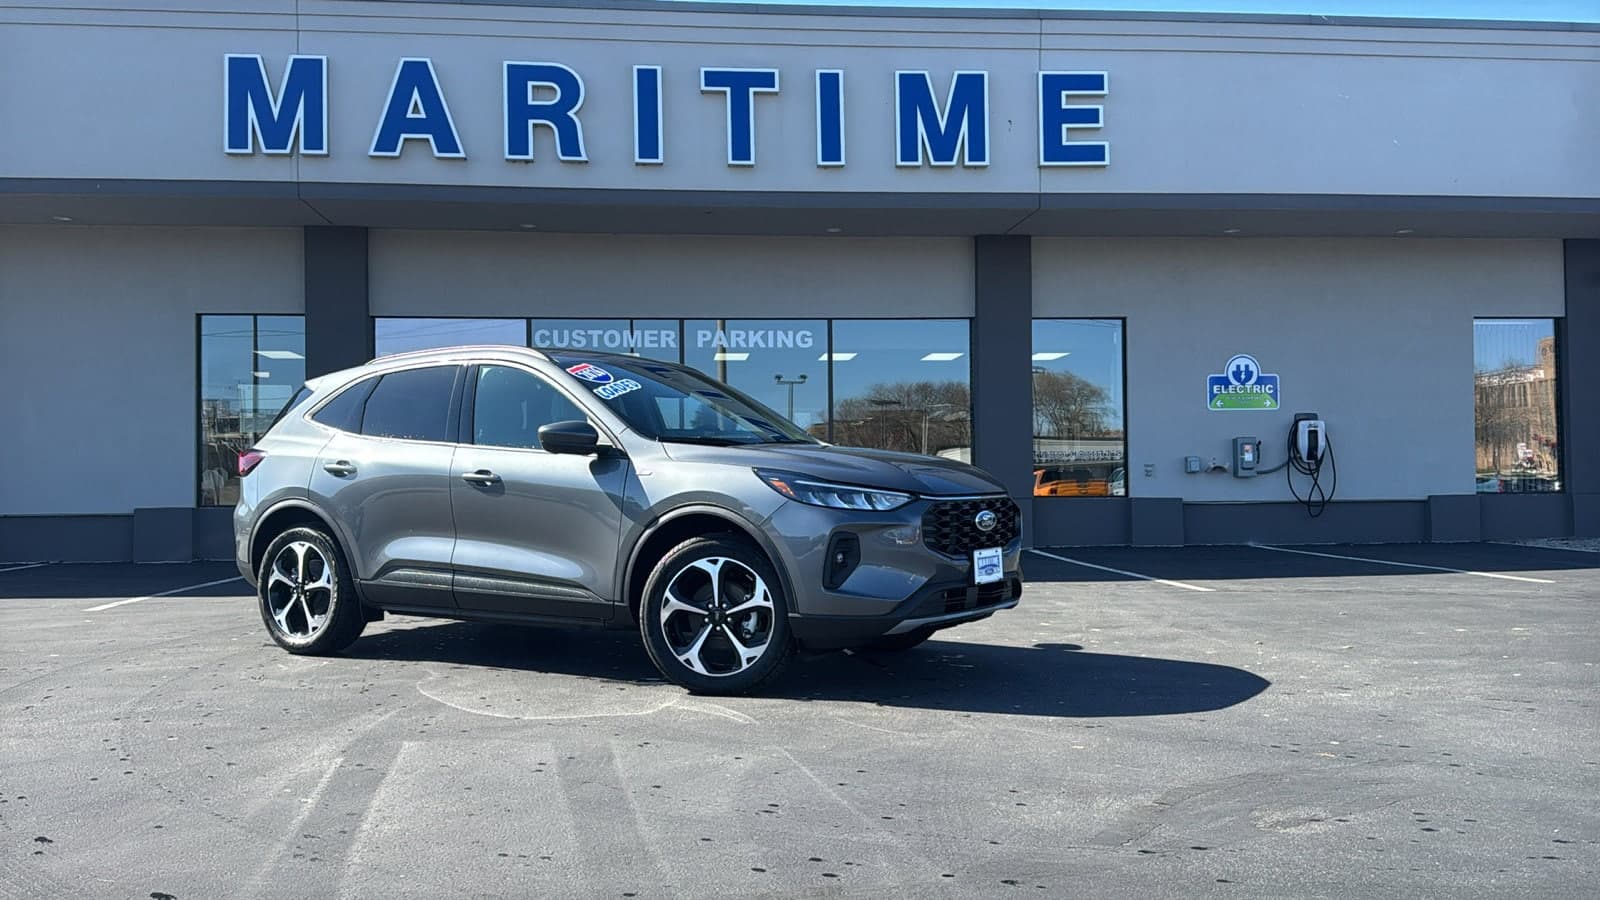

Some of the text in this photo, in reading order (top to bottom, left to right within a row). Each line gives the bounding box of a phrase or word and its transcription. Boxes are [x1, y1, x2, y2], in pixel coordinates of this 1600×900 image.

[223, 54, 1110, 168] MARITIME
[534, 329, 814, 348] CUSTOMER PARKING
[1213, 384, 1274, 394] ELECTRIC
